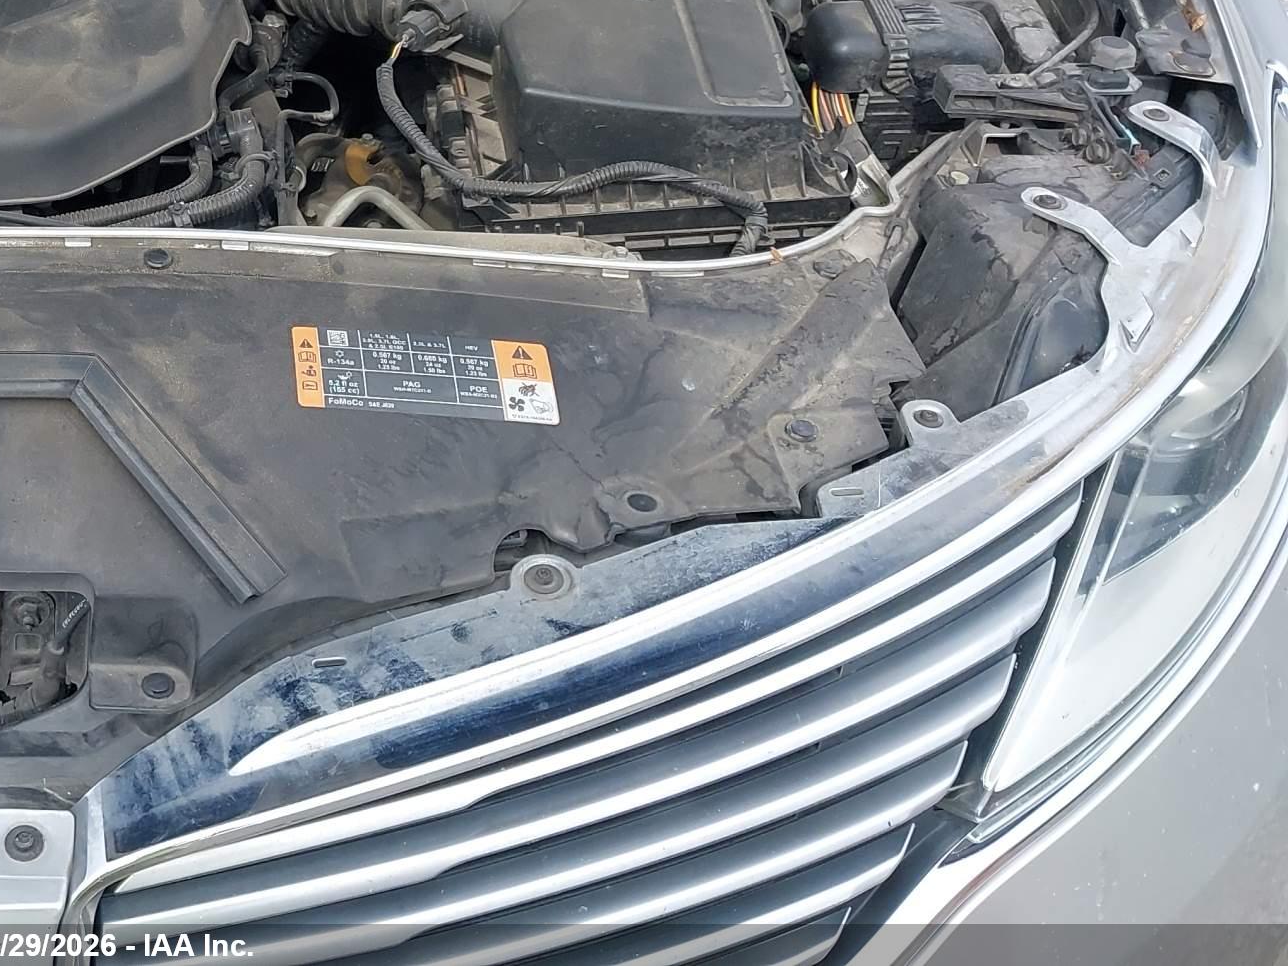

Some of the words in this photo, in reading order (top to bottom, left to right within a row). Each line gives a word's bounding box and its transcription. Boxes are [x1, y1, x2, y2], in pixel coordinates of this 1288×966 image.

[392, 352, 402, 360] kg
[438, 356, 448, 364] kg
[327, 358, 355, 366] R-134a
[402, 380, 421, 388] PAG
[347, 387, 360, 395] cc)
[469, 385, 489, 393] POE
[328, 397, 364, 407] FoMoCo
